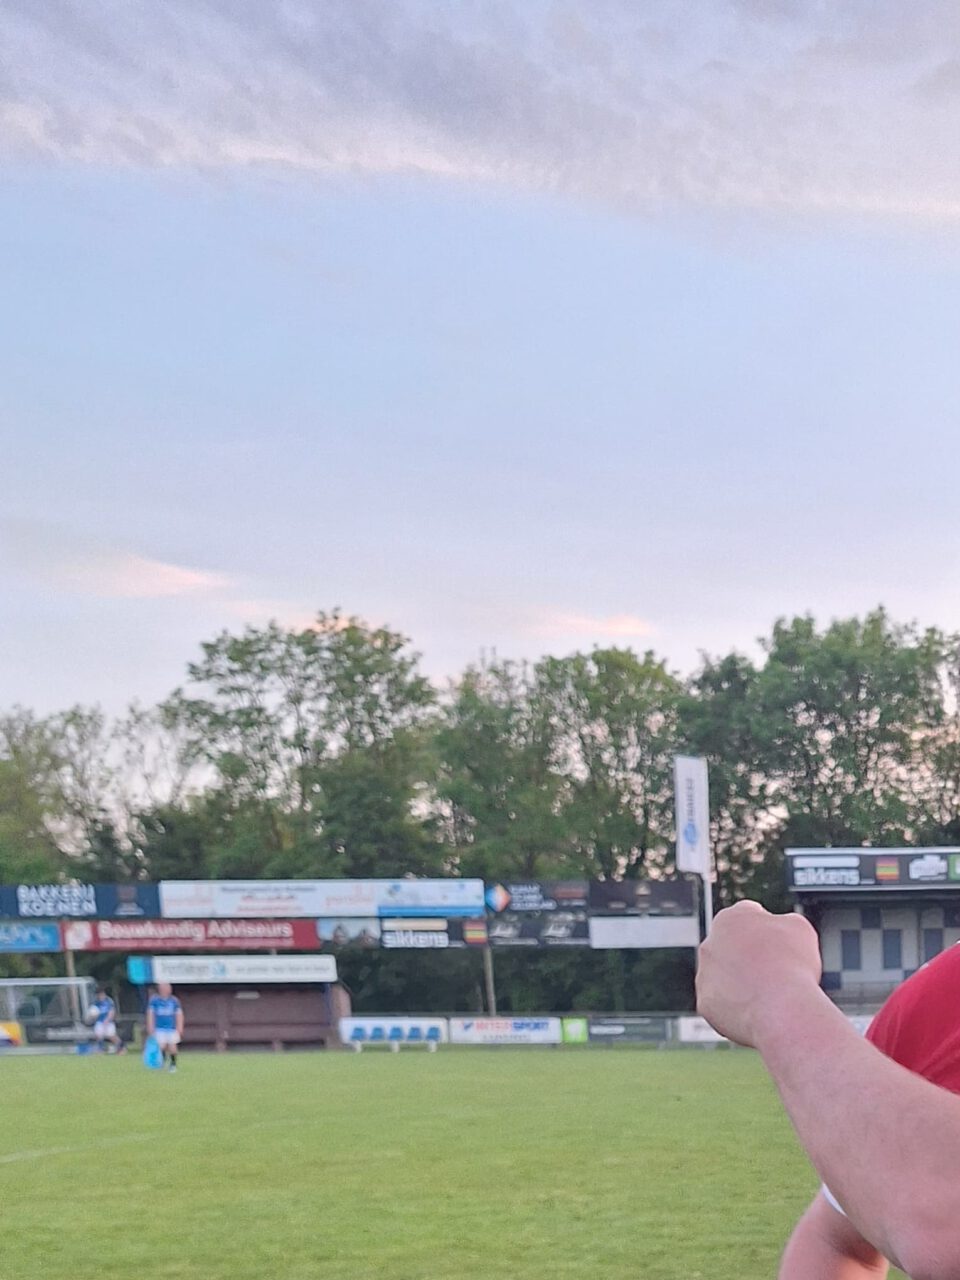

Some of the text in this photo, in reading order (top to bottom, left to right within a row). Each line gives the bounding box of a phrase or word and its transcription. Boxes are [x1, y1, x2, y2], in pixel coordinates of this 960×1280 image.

[794, 868, 860, 885] sikkens
[98, 920, 293, 942] Bouwkundig Adviseurs
[382, 930, 449, 948] sikkens
